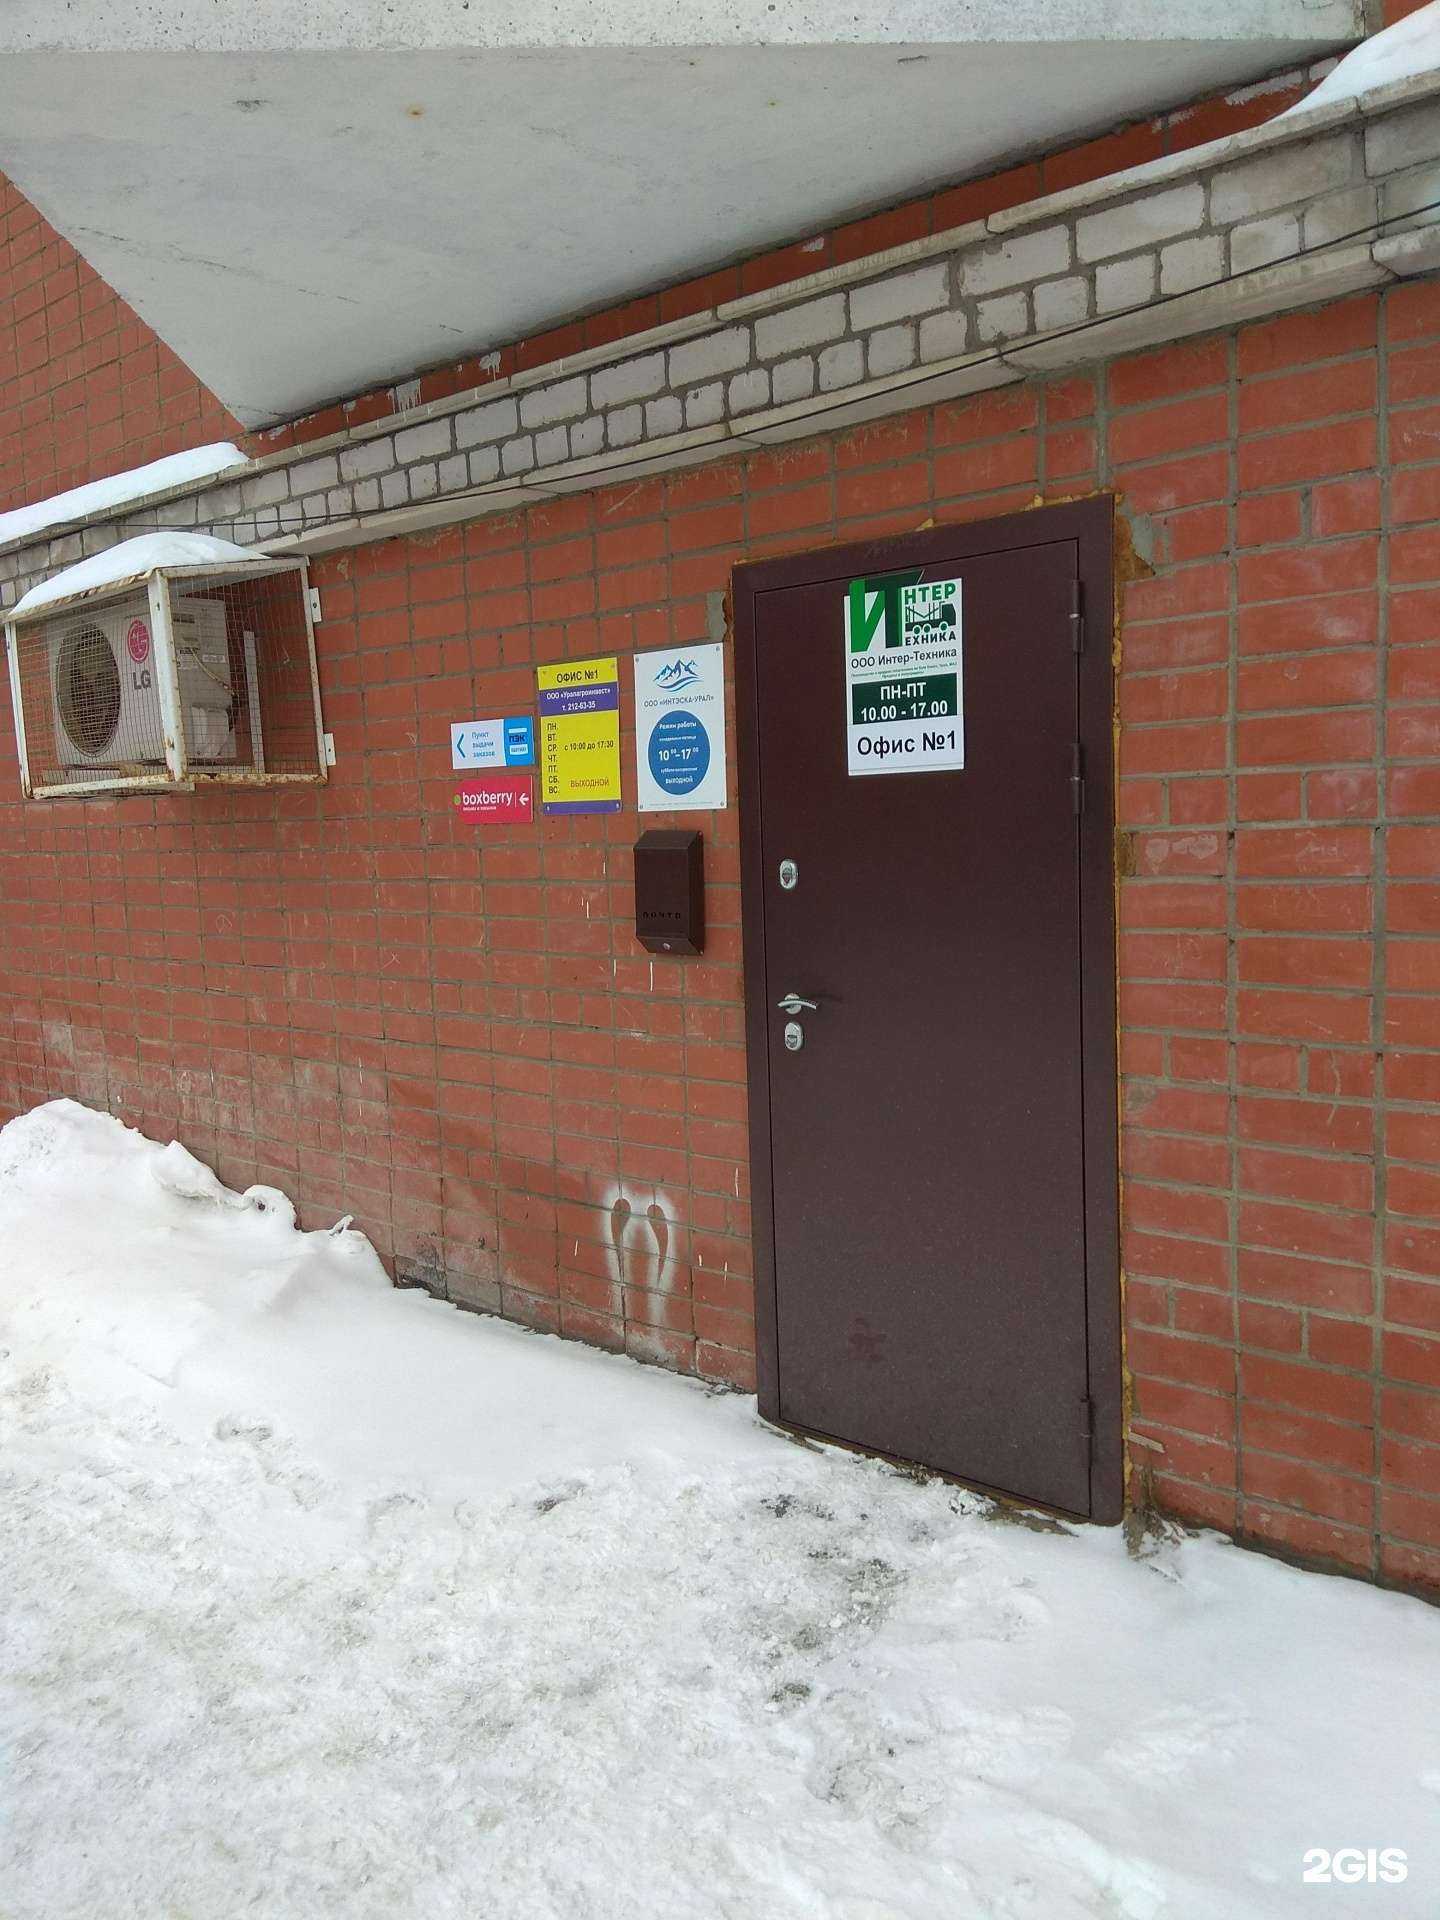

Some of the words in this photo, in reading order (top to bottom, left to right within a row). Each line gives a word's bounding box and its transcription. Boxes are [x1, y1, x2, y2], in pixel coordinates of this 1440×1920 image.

[904, 582, 957, 605] НТЕР
[905, 631, 957, 646] ЕХНИКА
[851, 656, 875, 669] ООО
[878, 648, 957, 666] Интер-Техника
[132, 669, 152, 690] LG
[556, 671, 582, 683] ОФИС
[584, 670, 599, 679] №1
[546, 692, 560, 700] ООО
[880, 682, 927, 701] ПН-ПТ
[644, 700, 658, 708] ООО
[861, 704, 897, 722] 10.00
[910, 700, 948, 718] 17.00
[857, 736, 916, 759] Офис
[922, 730, 955, 752] №1
[462, 790, 513, 806] boxberry
